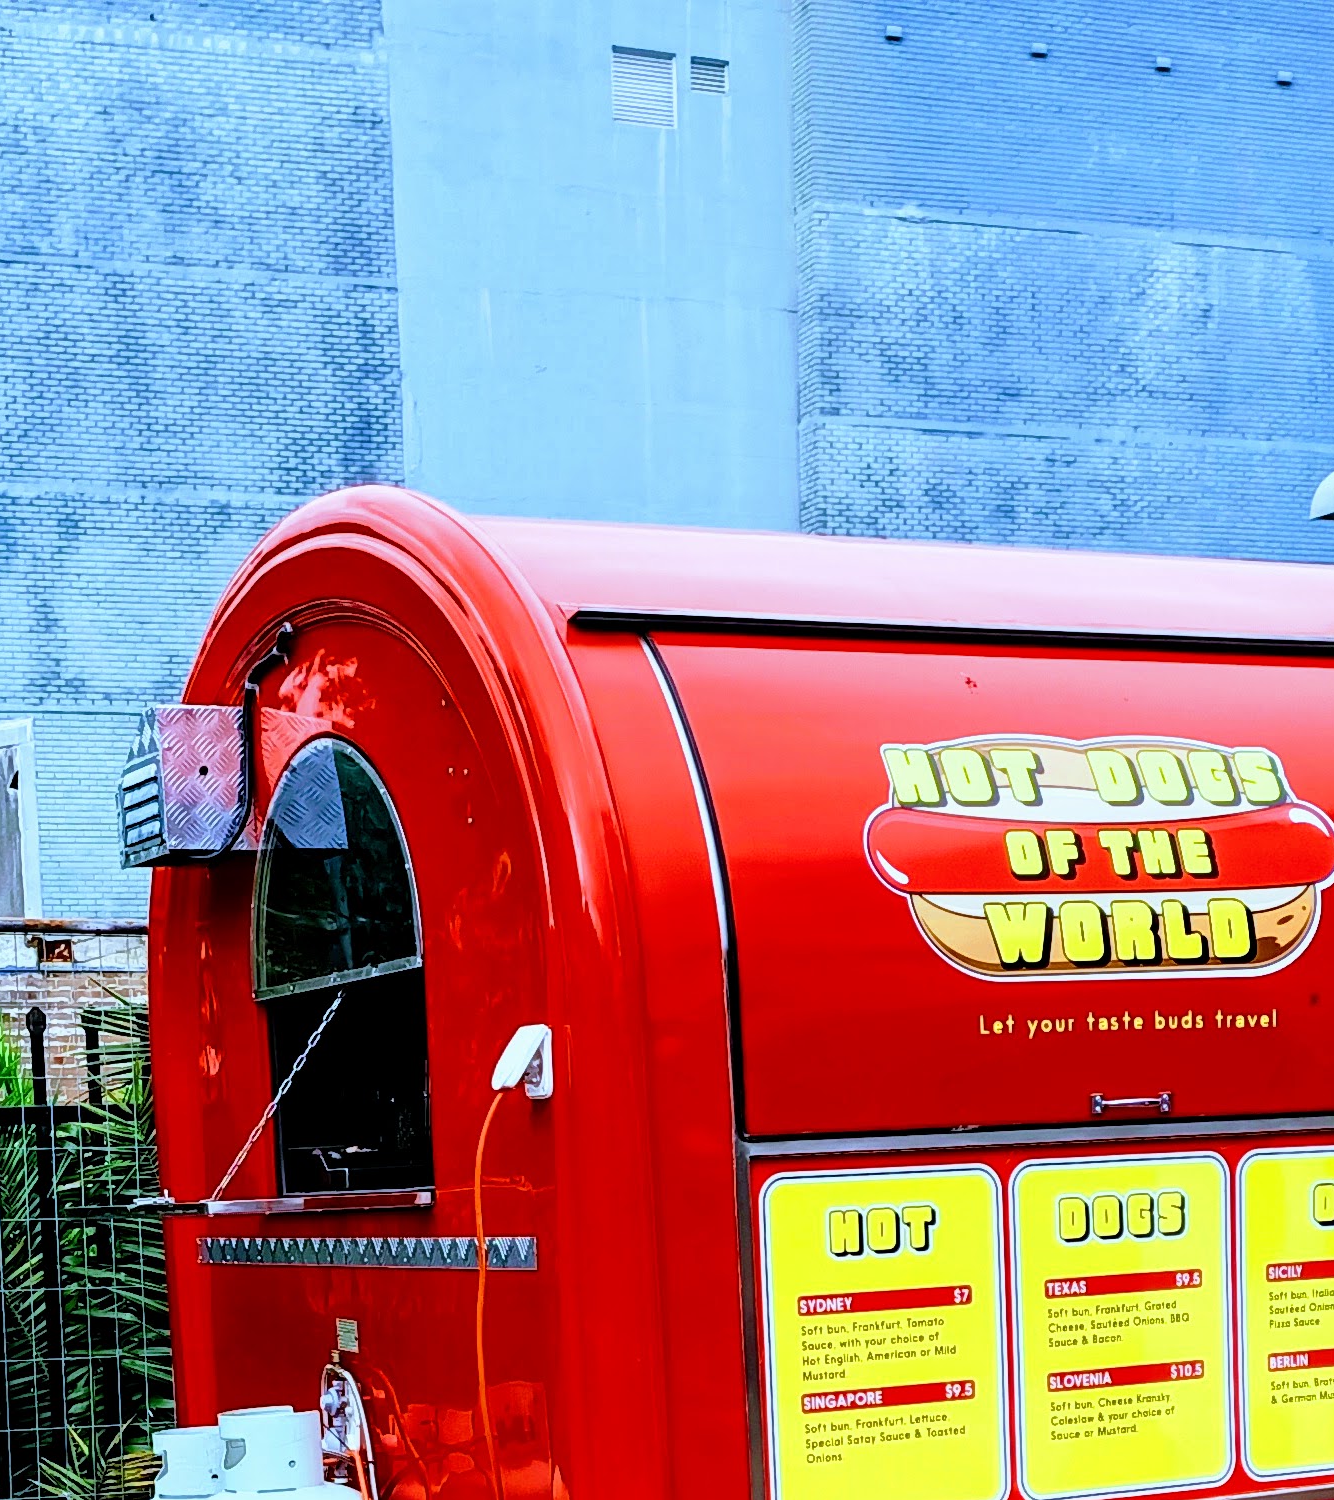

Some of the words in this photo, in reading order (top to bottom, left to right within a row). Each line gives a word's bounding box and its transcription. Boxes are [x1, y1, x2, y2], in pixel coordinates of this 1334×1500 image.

[883, 747, 1044, 807] HOT
[1086, 748, 1287, 807] DOGS
[1004, 829, 1085, 882] OF
[1098, 828, 1220, 882] THE
[983, 898, 1259, 971] WORLD
[979, 1014, 1016, 1035] Let
[1027, 1015, 1075, 1038] your
[1087, 1012, 1144, 1032] taste
[1155, 1009, 1205, 1030] buds
[1215, 1008, 1278, 1029] travel
[1059, 1191, 1185, 1243] DOGS
[828, 1205, 936, 1257] HOT
[1269, 1265, 1302, 1279] SICILY
[1047, 1281, 1086, 1296] TEXAS
[1176, 1272, 1200, 1286] $9.5
[799, 1297, 852, 1313] SYDNEY
[953, 1288, 969, 1303] $7
[1269, 1291, 1287, 1301] Soft
[1048, 1308, 1068, 1319] Soft
[1145, 1301, 1176, 1311] Grated
[1170, 1313, 1189, 1323] BBQ
[801, 1326, 823, 1336] Soft
[907, 1317, 944, 1328] Tomato
[840, 1338, 860, 1348] with
[865, 1336, 886, 1348] your
[891, 1334, 924, 1344] choice
[929, 1332, 939, 1341] of
[1049, 1337, 1078, 1347] Sauce
[1082, 1336, 1088, 1345] &
[803, 1355, 820, 1366] Hot
[867, 1350, 916, 1361] American
[935, 1345, 956, 1355] Mild
[1269, 1354, 1308, 1369] BERLIN
[1050, 1372, 1112, 1389] SLOVENIA
[1170, 1364, 1202, 1379] $10.5
[1271, 1381, 1289, 1391] Soft
[804, 1391, 882, 1410] SINGAPORE
[945, 1383, 972, 1398] $9.5
[1051, 1402, 1070, 1411] Soft
[1098, 1398, 1132, 1407] Cheese
[1271, 1396, 1277, 1404] &
[1282, 1393, 1316, 1404] German
[1051, 1416, 1094, 1426] Coleslaw
[1098, 1412, 1104, 1422] &
[1108, 1413, 1127, 1423] your
[1132, 1409, 1161, 1418] choice
[1165, 1406, 1175, 1415] of
[805, 1423, 826, 1434] Soft
[806, 1436, 843, 1449] Special
[847, 1435, 875, 1445] Satay
[880, 1432, 910, 1442] Sauce
[915, 1429, 921, 1438] &
[927, 1426, 965, 1437] Toasted
[1051, 1431, 1080, 1440] Sauce
